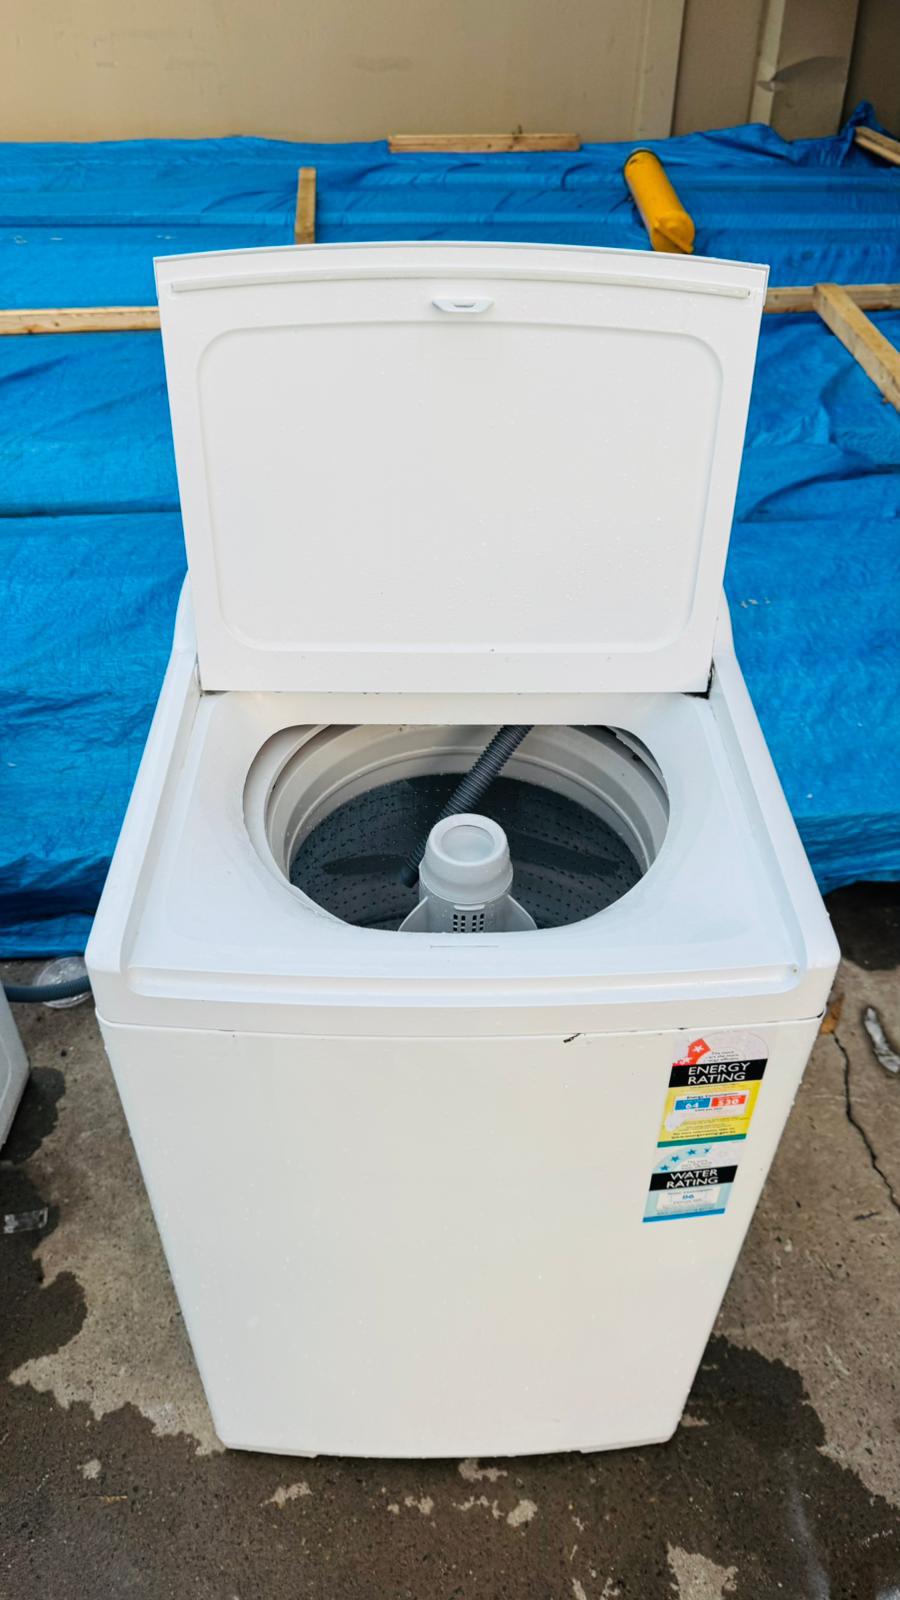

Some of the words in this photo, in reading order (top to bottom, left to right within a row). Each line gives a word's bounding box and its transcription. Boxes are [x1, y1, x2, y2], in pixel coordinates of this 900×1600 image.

[688, 1062, 751, 1076] ENERGY
[688, 1072, 747, 1085] RATING
[670, 1168, 718, 1181] WATER
[666, 1177, 719, 1188] RATING
